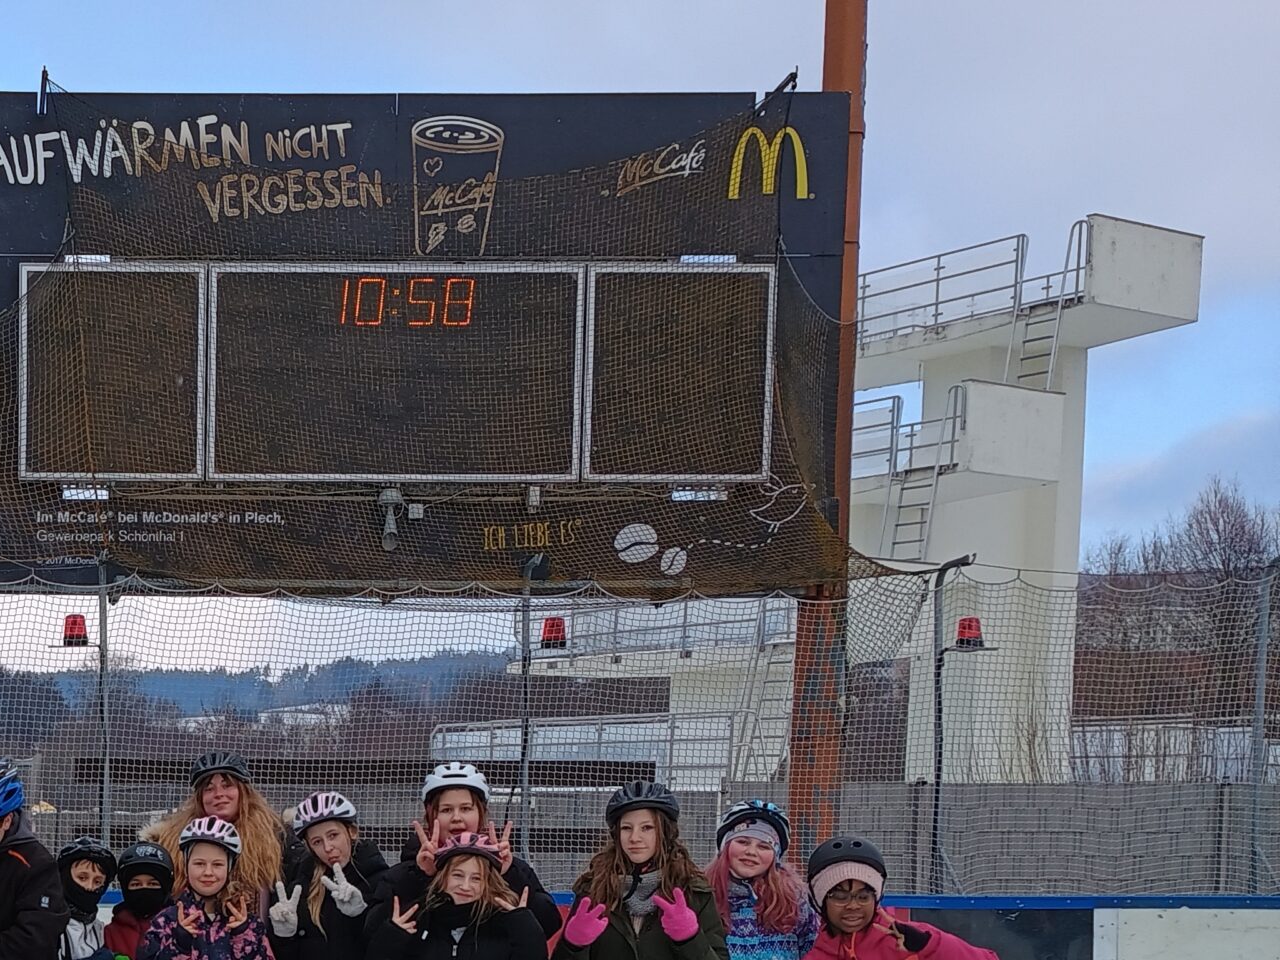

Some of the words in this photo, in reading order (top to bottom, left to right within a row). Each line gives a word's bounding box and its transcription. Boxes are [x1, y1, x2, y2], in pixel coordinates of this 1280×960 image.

[196, 164, 391, 223] VERGESSEN.
[340, 278, 475, 326] 10:58
[36, 511, 53, 523] Im
[118, 511, 138, 523] bei
[228, 512, 240, 523] in
[245, 511, 285, 525] Plech,
[36, 529, 115, 544] Gewerbepak
[483, 525, 506, 550] ICH
[513, 521, 553, 548] LIEBE
